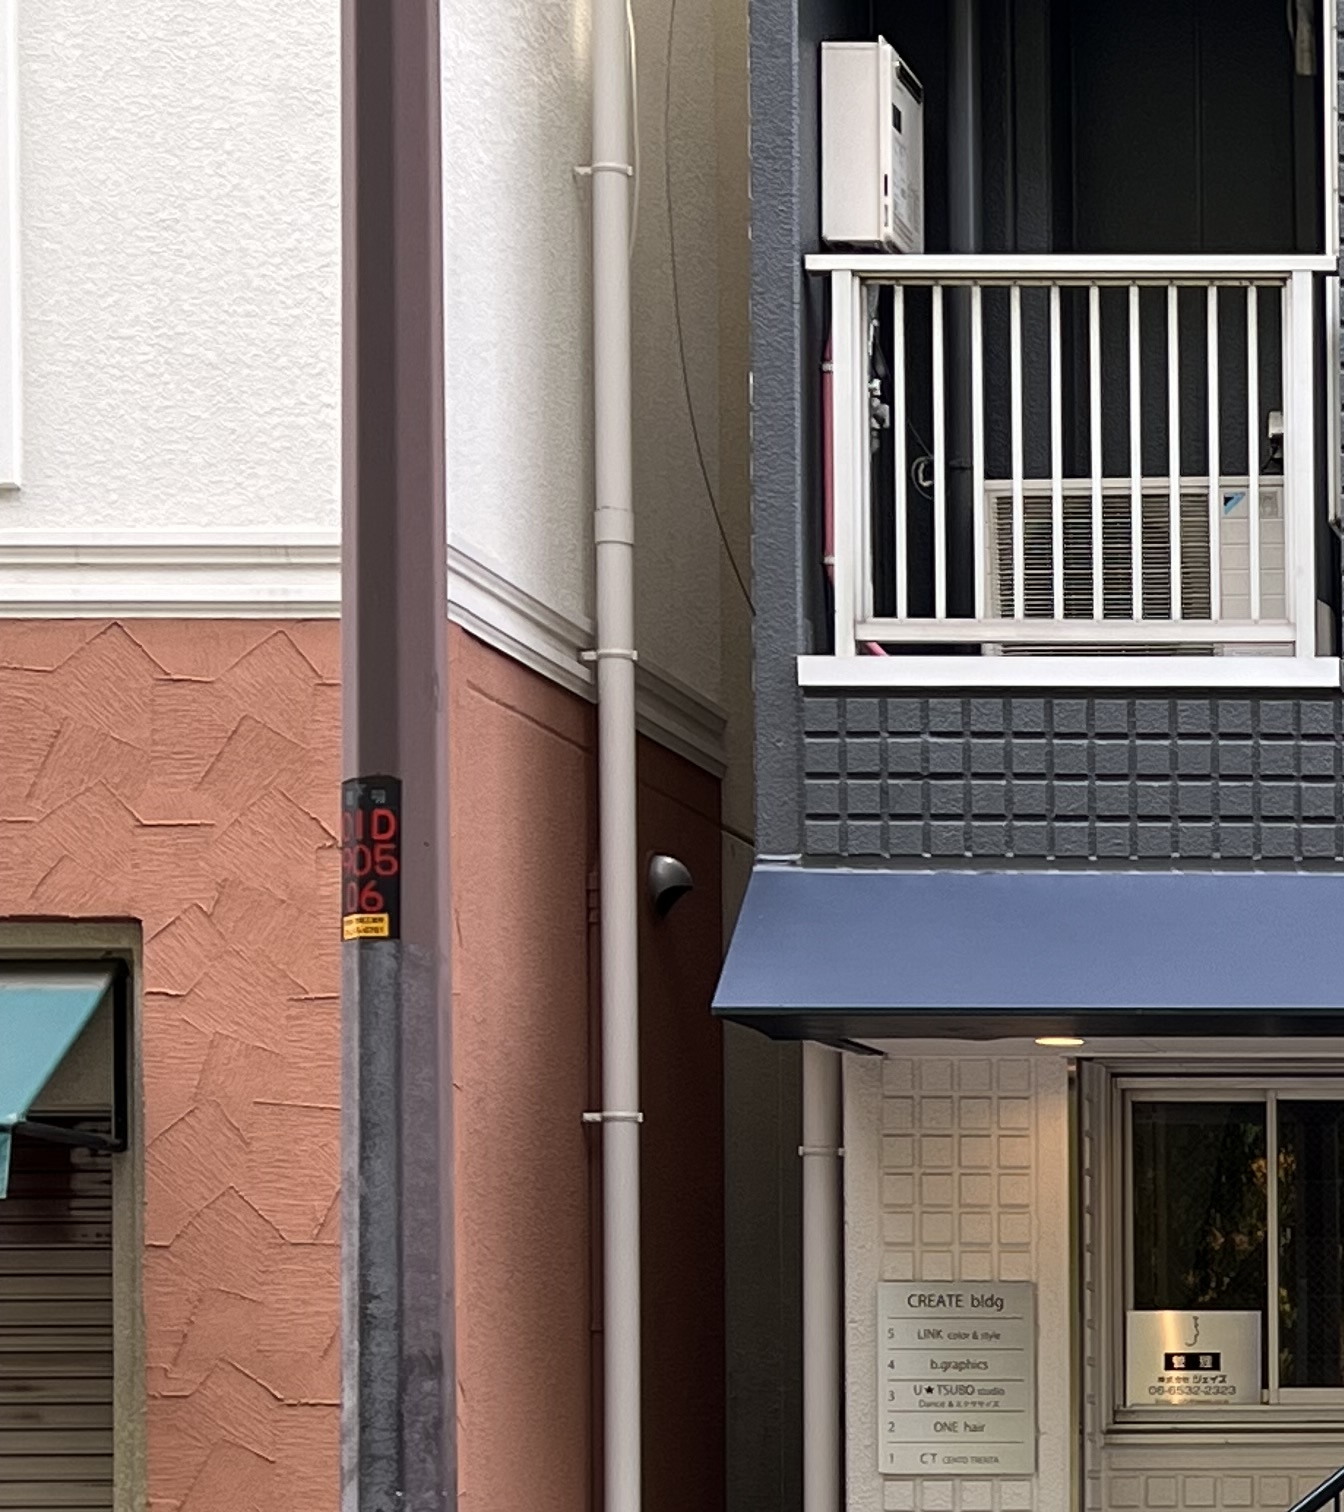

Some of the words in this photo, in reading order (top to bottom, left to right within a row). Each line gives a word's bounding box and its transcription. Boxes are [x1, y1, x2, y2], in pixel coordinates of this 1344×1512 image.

[907, 1293, 965, 1308] CREATE
[970, 1293, 1005, 1312] bldg
[887, 1328, 895, 1339] 5
[917, 1329, 944, 1340] LINK
[887, 1359, 895, 1370] 4
[930, 1358, 989, 1373] b.graphics
[887, 1390, 896, 1402] 3
[887, 1421, 896, 1432] 2
[933, 1421, 959, 1433] ONE
[963, 1420, 986, 1432] hair
